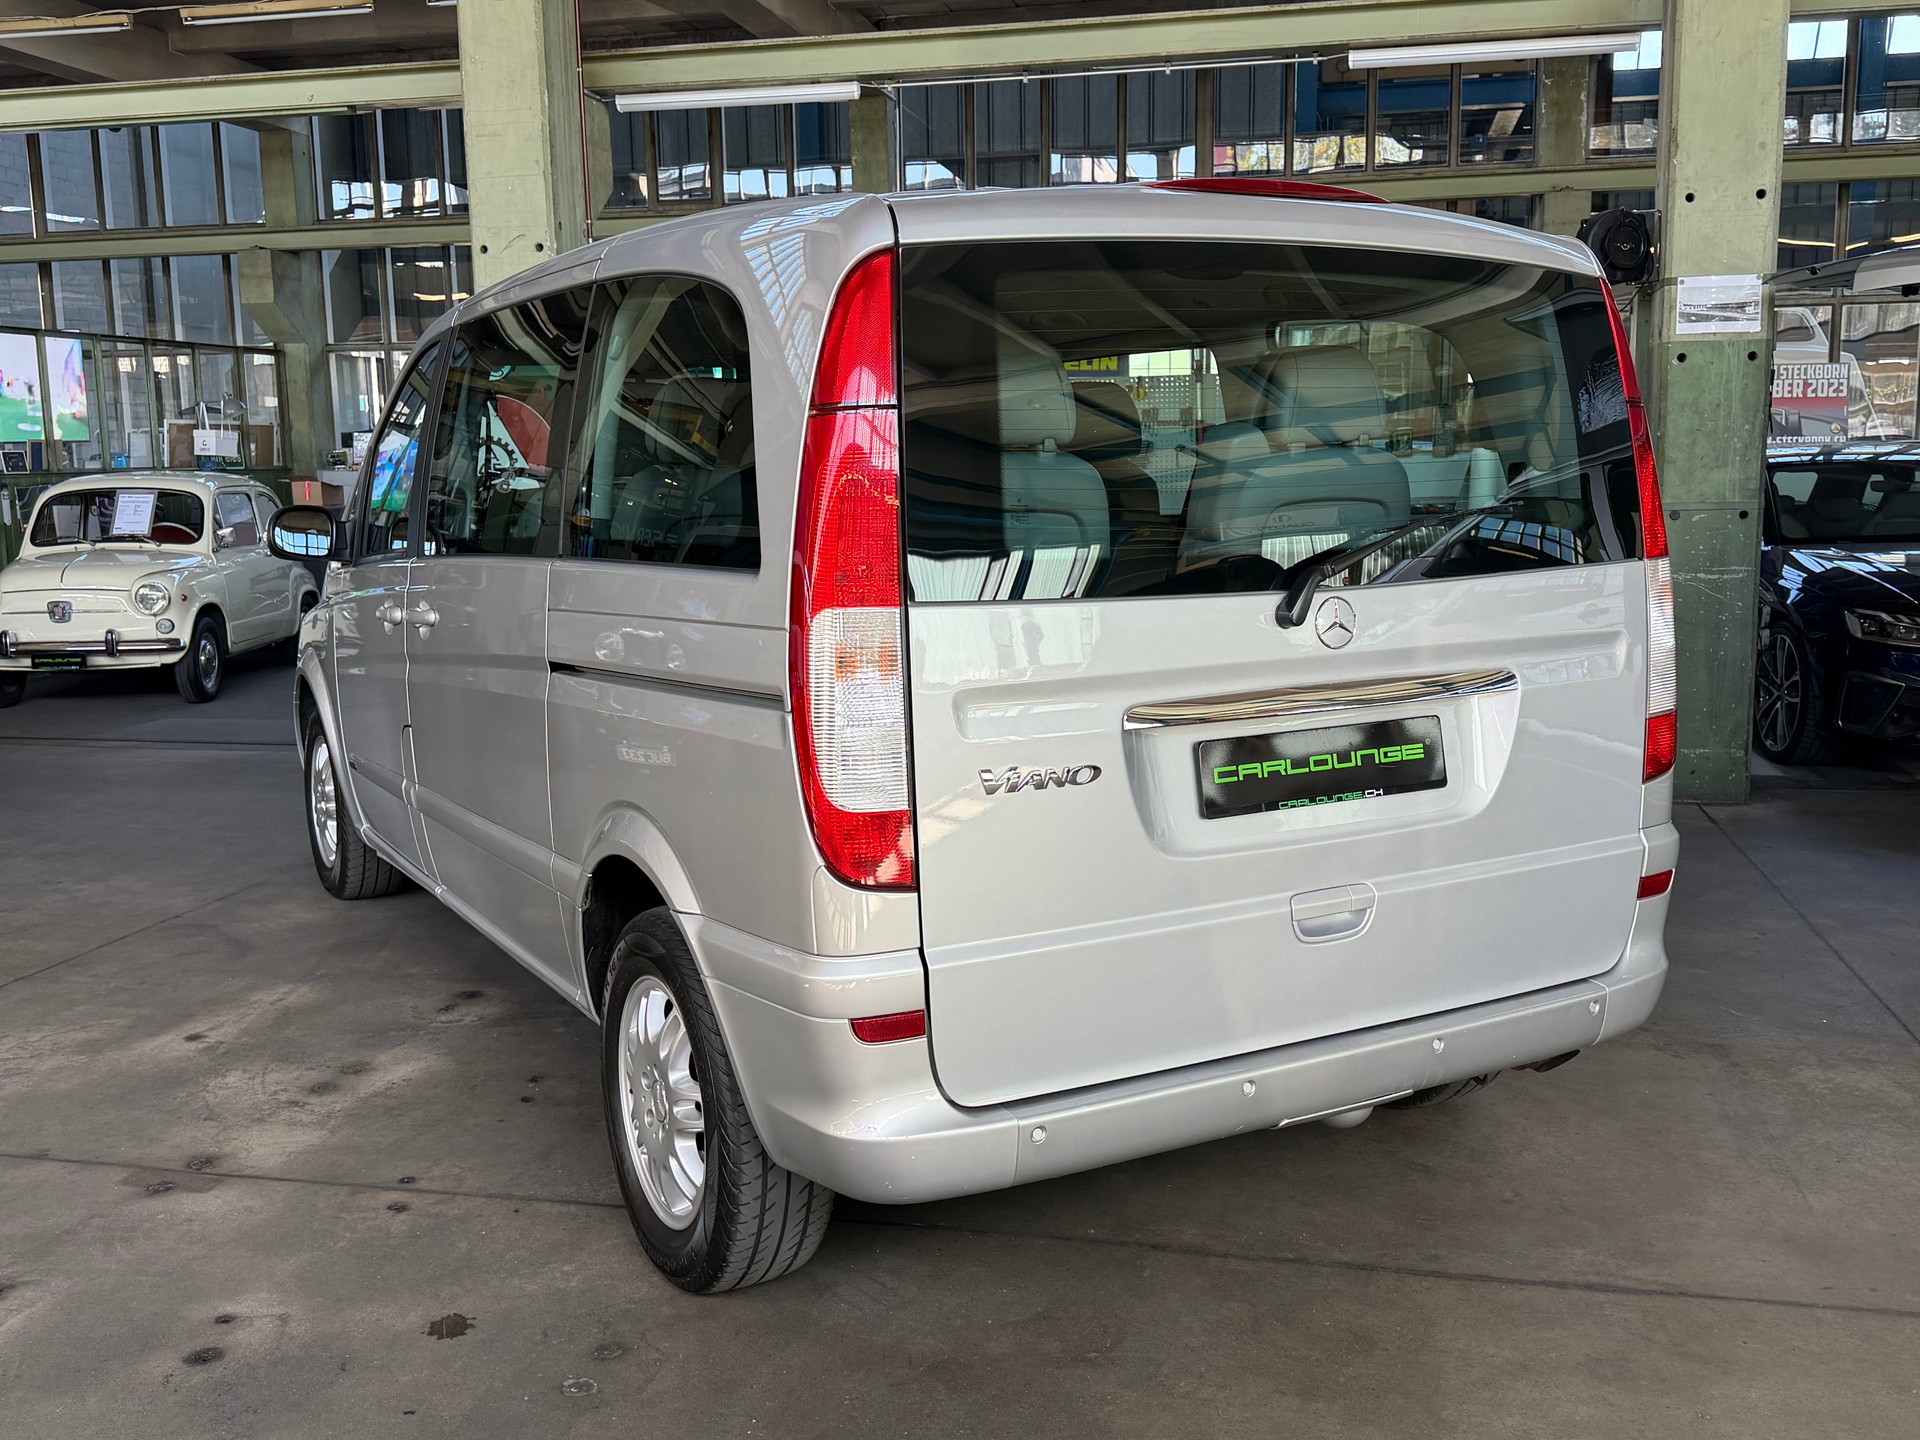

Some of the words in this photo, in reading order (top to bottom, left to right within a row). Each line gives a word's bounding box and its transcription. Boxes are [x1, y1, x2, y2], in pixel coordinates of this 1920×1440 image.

[1780, 364, 1849, 379] STECKBORN
[1806, 379, 1848, 398] 2023
[1213, 743, 1425, 784] CARLOUNGE
[978, 765, 1102, 795] VIANO
[1279, 788, 1383, 810] CARLOUNGE.CH
